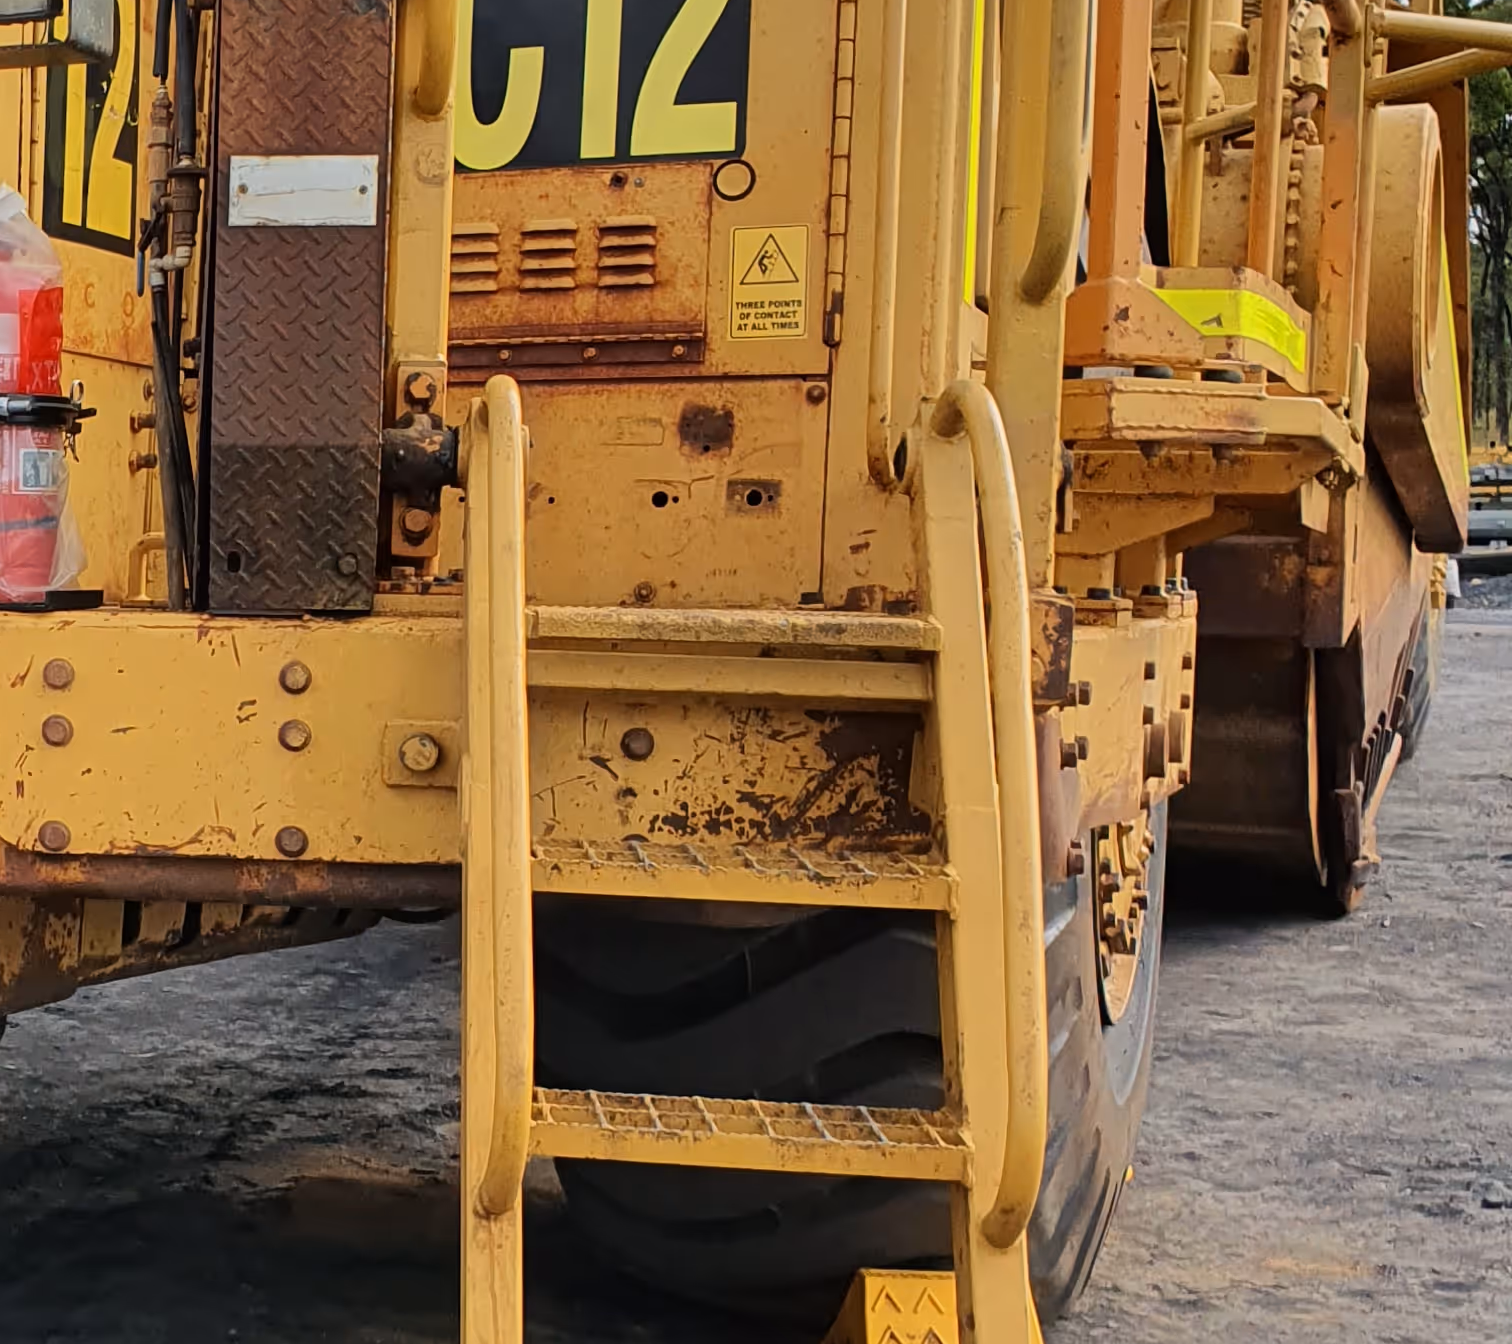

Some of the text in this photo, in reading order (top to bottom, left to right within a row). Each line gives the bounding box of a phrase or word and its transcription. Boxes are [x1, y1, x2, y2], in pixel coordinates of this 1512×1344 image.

[735, 300, 802, 310] THREE POINTS
[739, 311, 798, 320] OF CONTACT
[737, 323, 748, 331] AT
[751, 322, 768, 330] ALL
